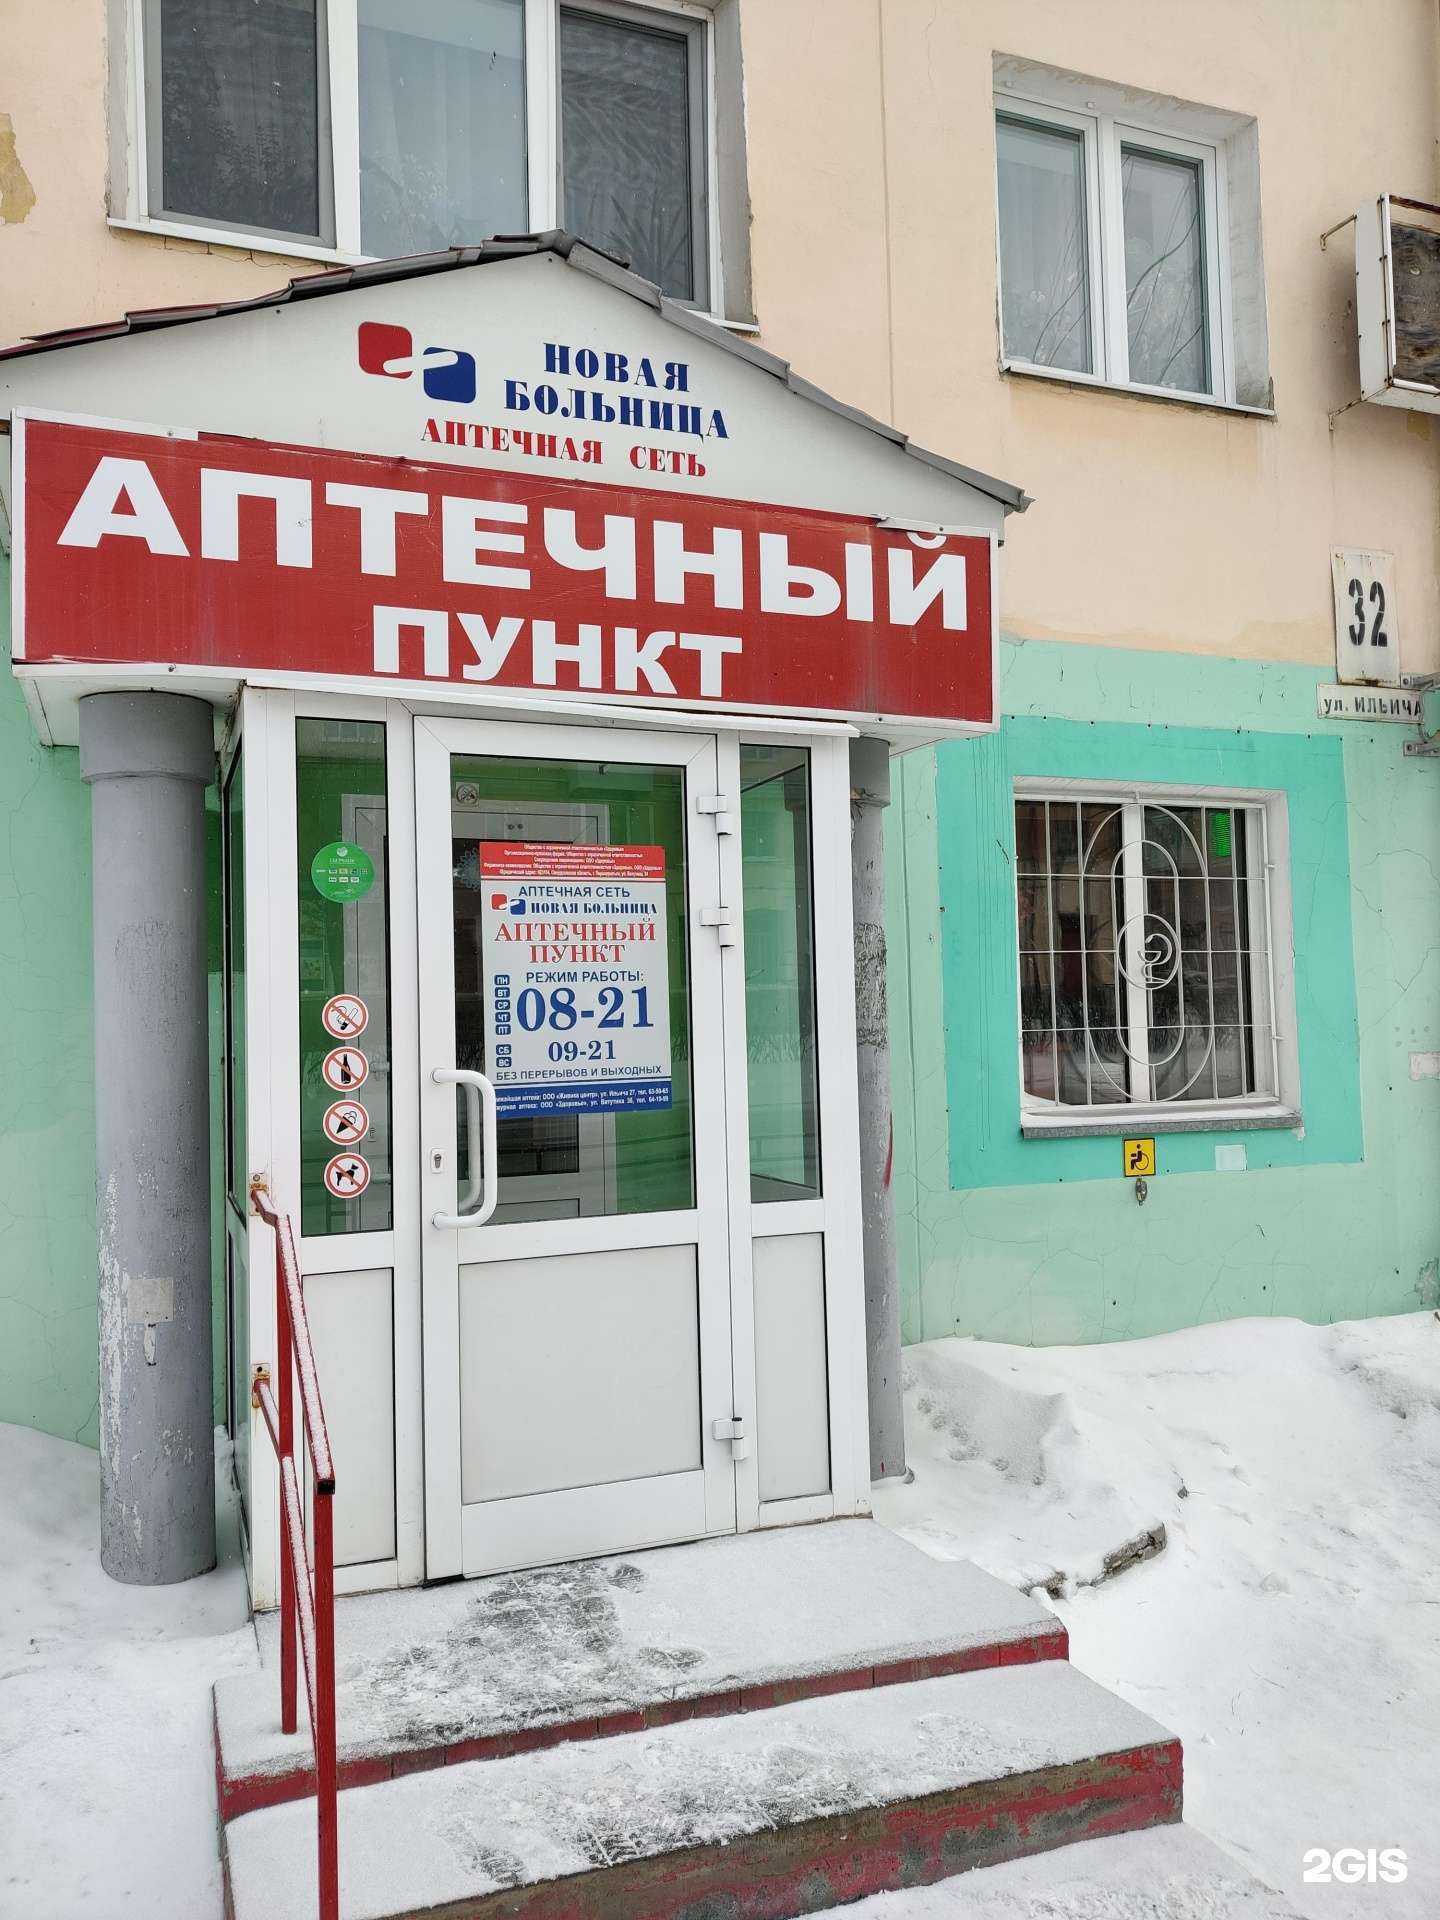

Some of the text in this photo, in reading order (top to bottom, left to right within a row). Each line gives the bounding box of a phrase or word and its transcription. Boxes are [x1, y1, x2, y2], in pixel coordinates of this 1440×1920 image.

[543, 342, 690, 393] НОВАЯ
[504, 379, 730, 443] БОЛЬНИЦА
[421, 418, 707, 478] АПТЕЧНАЯ СЕТЬ
[57, 455, 967, 631] АПТЕЧНЫЙ
[1349, 578, 1387, 647] 32
[373, 605, 743, 697] ПУНКТ
[518, 886, 630, 898] АПТЕЧНАЯ СЕТЬ
[531, 902, 657, 915] НОВАЯ БОЛЬНИЦА
[494, 917, 656, 942] АПТЕЧНЫЙ
[529, 944, 626, 964] ПУНКТ
[526, 970, 644, 983] РЕЖИМ РАБОТЫ:
[516, 986, 654, 1032] 08-21
[548, 1040, 616, 1062] 09-21
[496, 1065, 662, 1081] БЕЗ ПЕРЕРЫВОВ И ВЫХОДНЫХ
